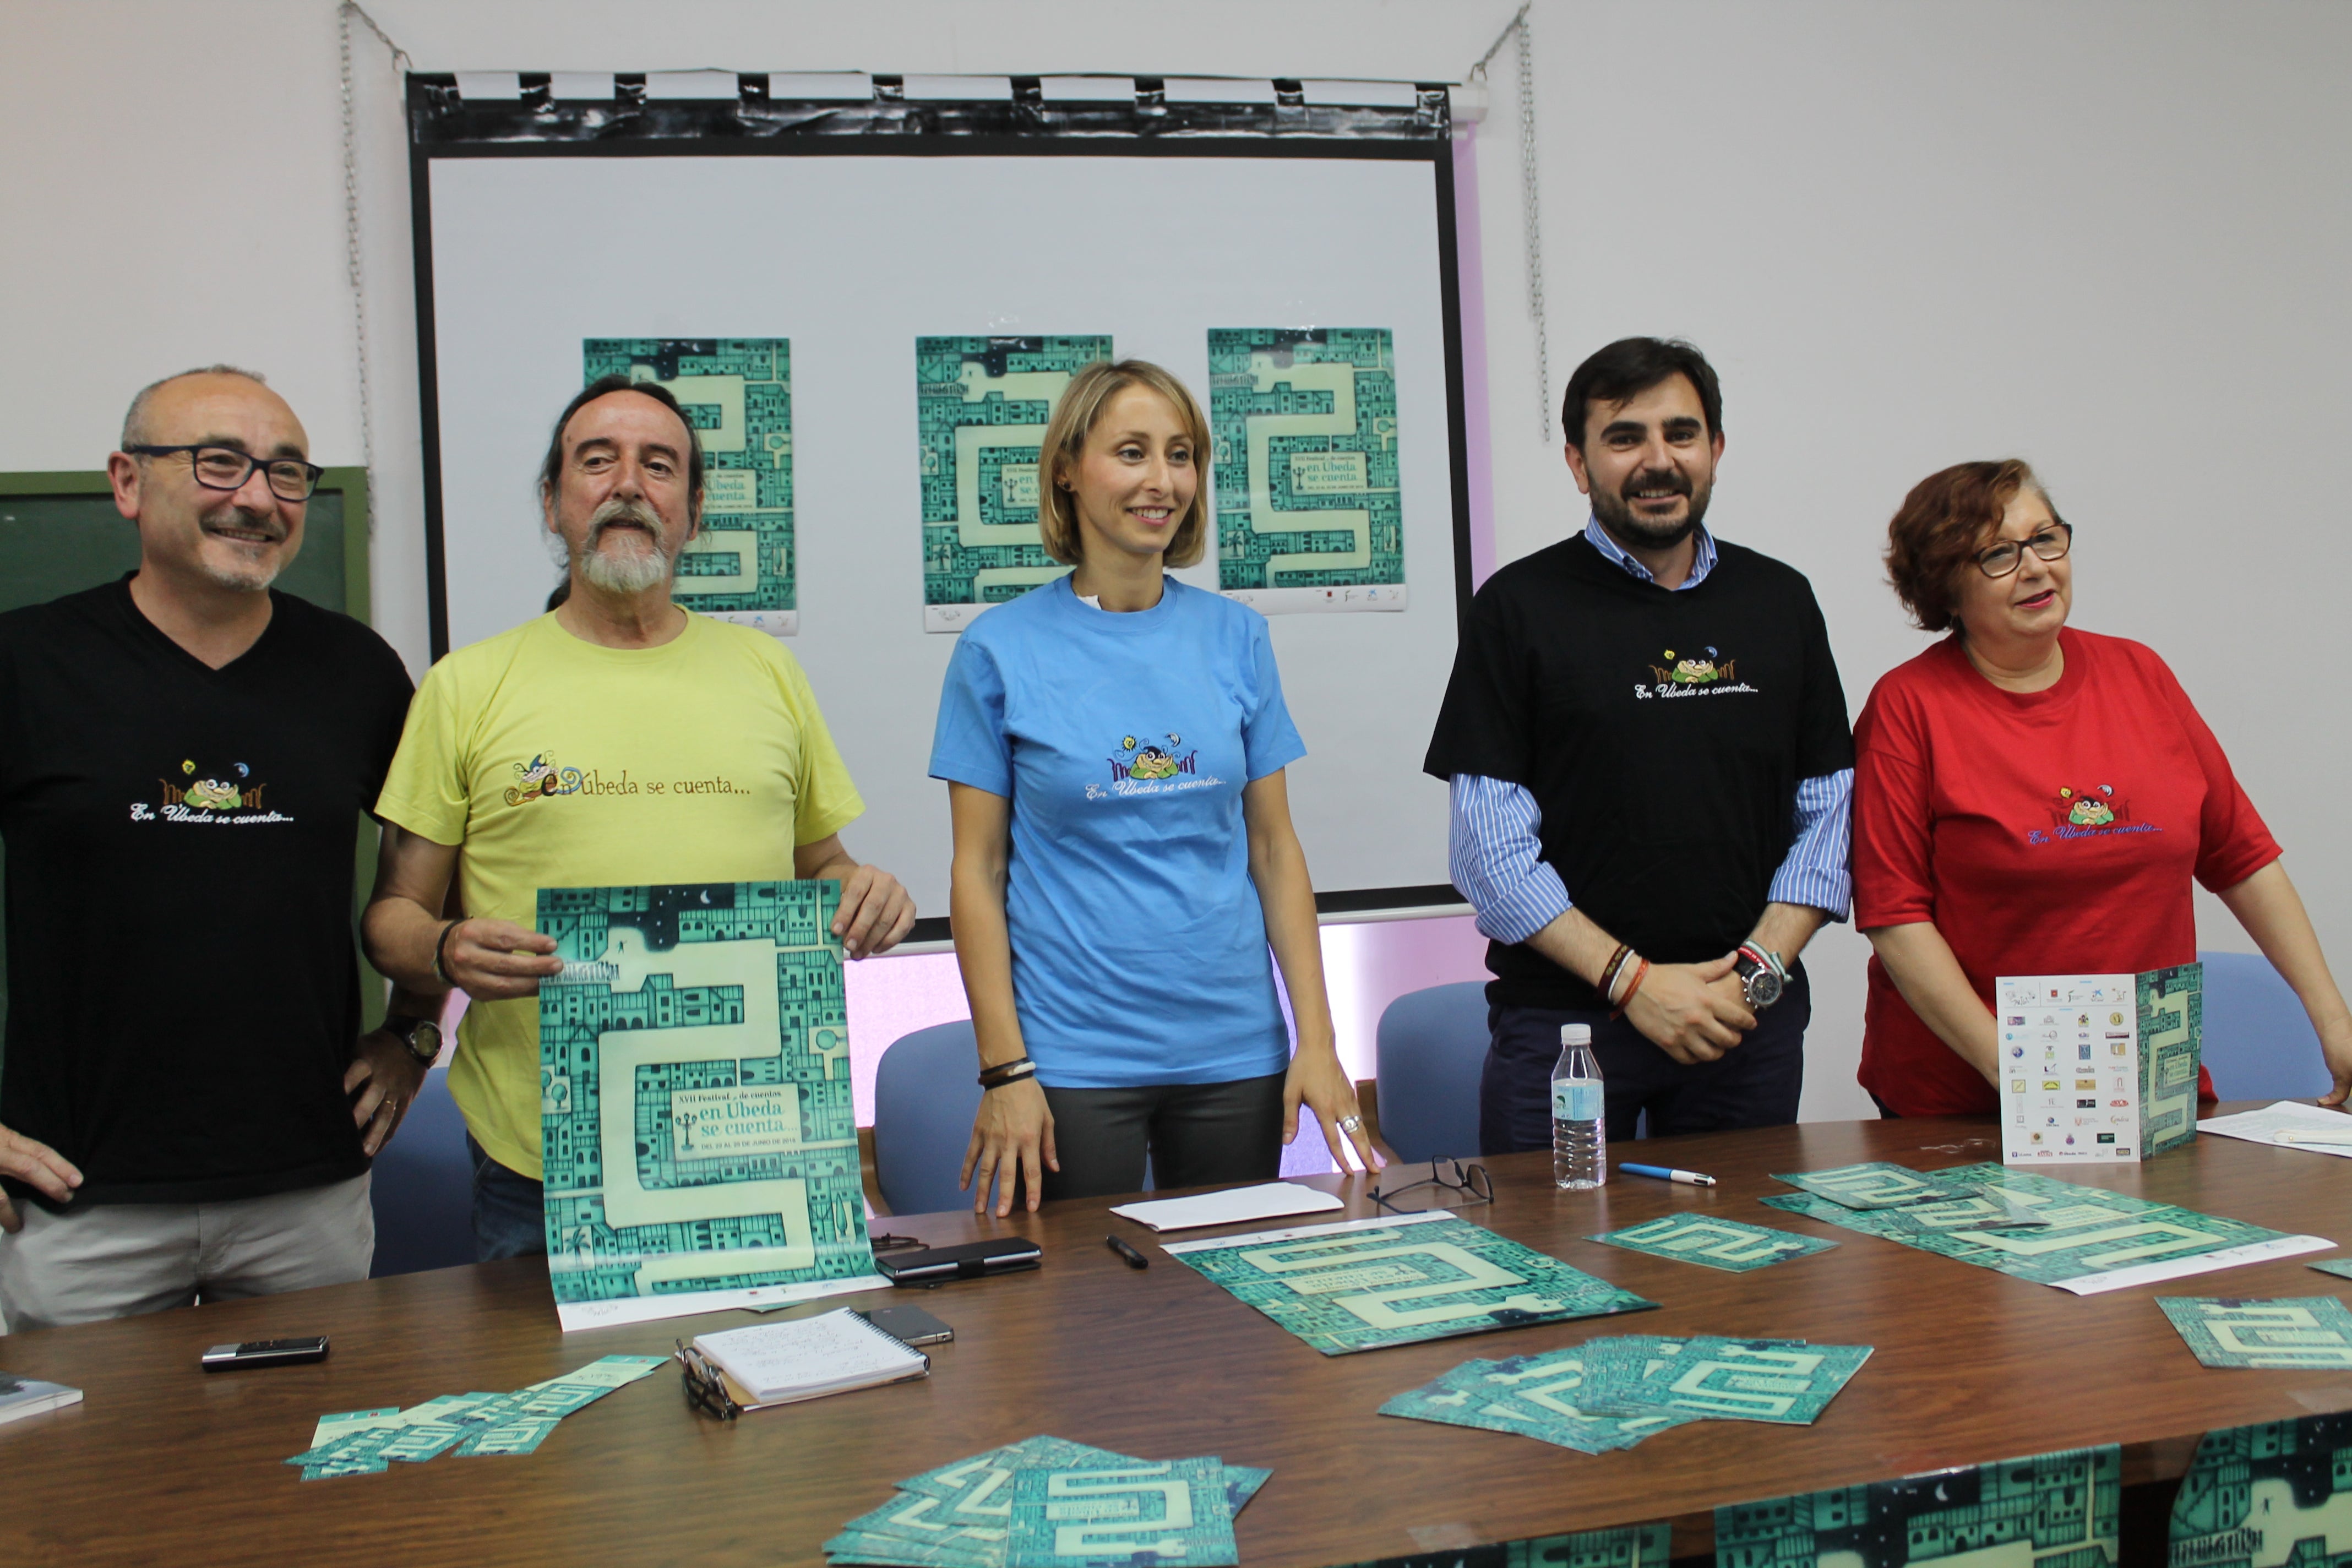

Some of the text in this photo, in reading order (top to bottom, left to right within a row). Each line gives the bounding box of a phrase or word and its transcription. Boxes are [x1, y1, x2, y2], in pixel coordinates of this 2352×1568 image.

[1635, 684, 1652, 699] En
[647, 782, 665, 794] se
[673, 776, 750, 794] cuenta...
[1085, 783, 1108, 801] En
[1162, 783, 1174, 792] se
[130, 803, 156, 822] En
[215, 815, 232, 824] se
[2028, 830, 2050, 845] En
[679, 1093, 696, 1104] XVII
[698, 1092, 730, 1102] Festival
[739, 1090, 749, 1099] de
[699, 1107, 724, 1121] en
[701, 1123, 721, 1137] se
